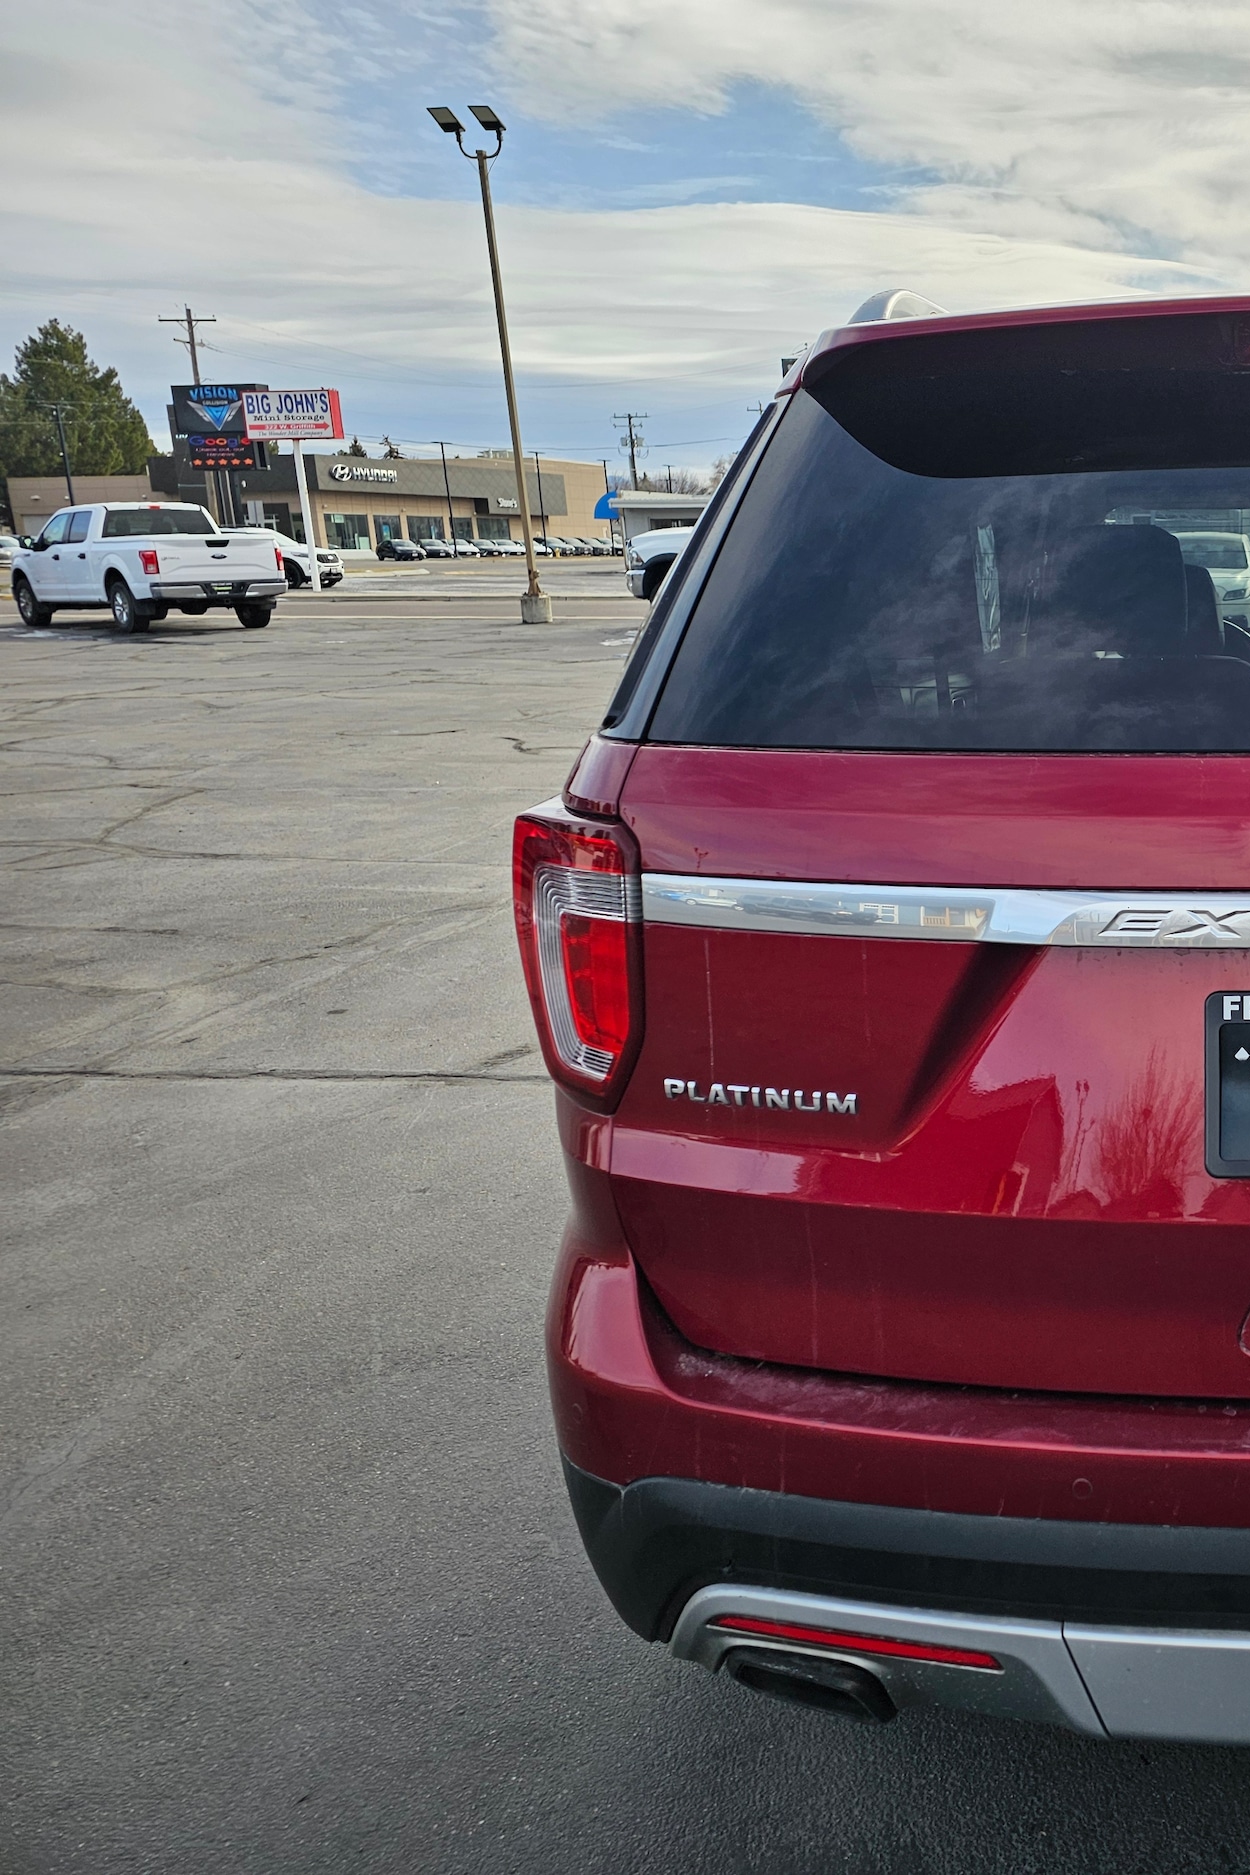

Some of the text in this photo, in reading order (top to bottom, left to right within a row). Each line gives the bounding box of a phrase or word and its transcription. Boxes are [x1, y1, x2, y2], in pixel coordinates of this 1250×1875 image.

[189, 386, 238, 401] VISION
[245, 393, 329, 414] BIG JOHN'S
[284, 414, 325, 422] Storage
[189, 435, 251, 448] Google
[352, 466, 398, 482] HYUNDAI
[663, 1078, 857, 1115] PLATINUM
